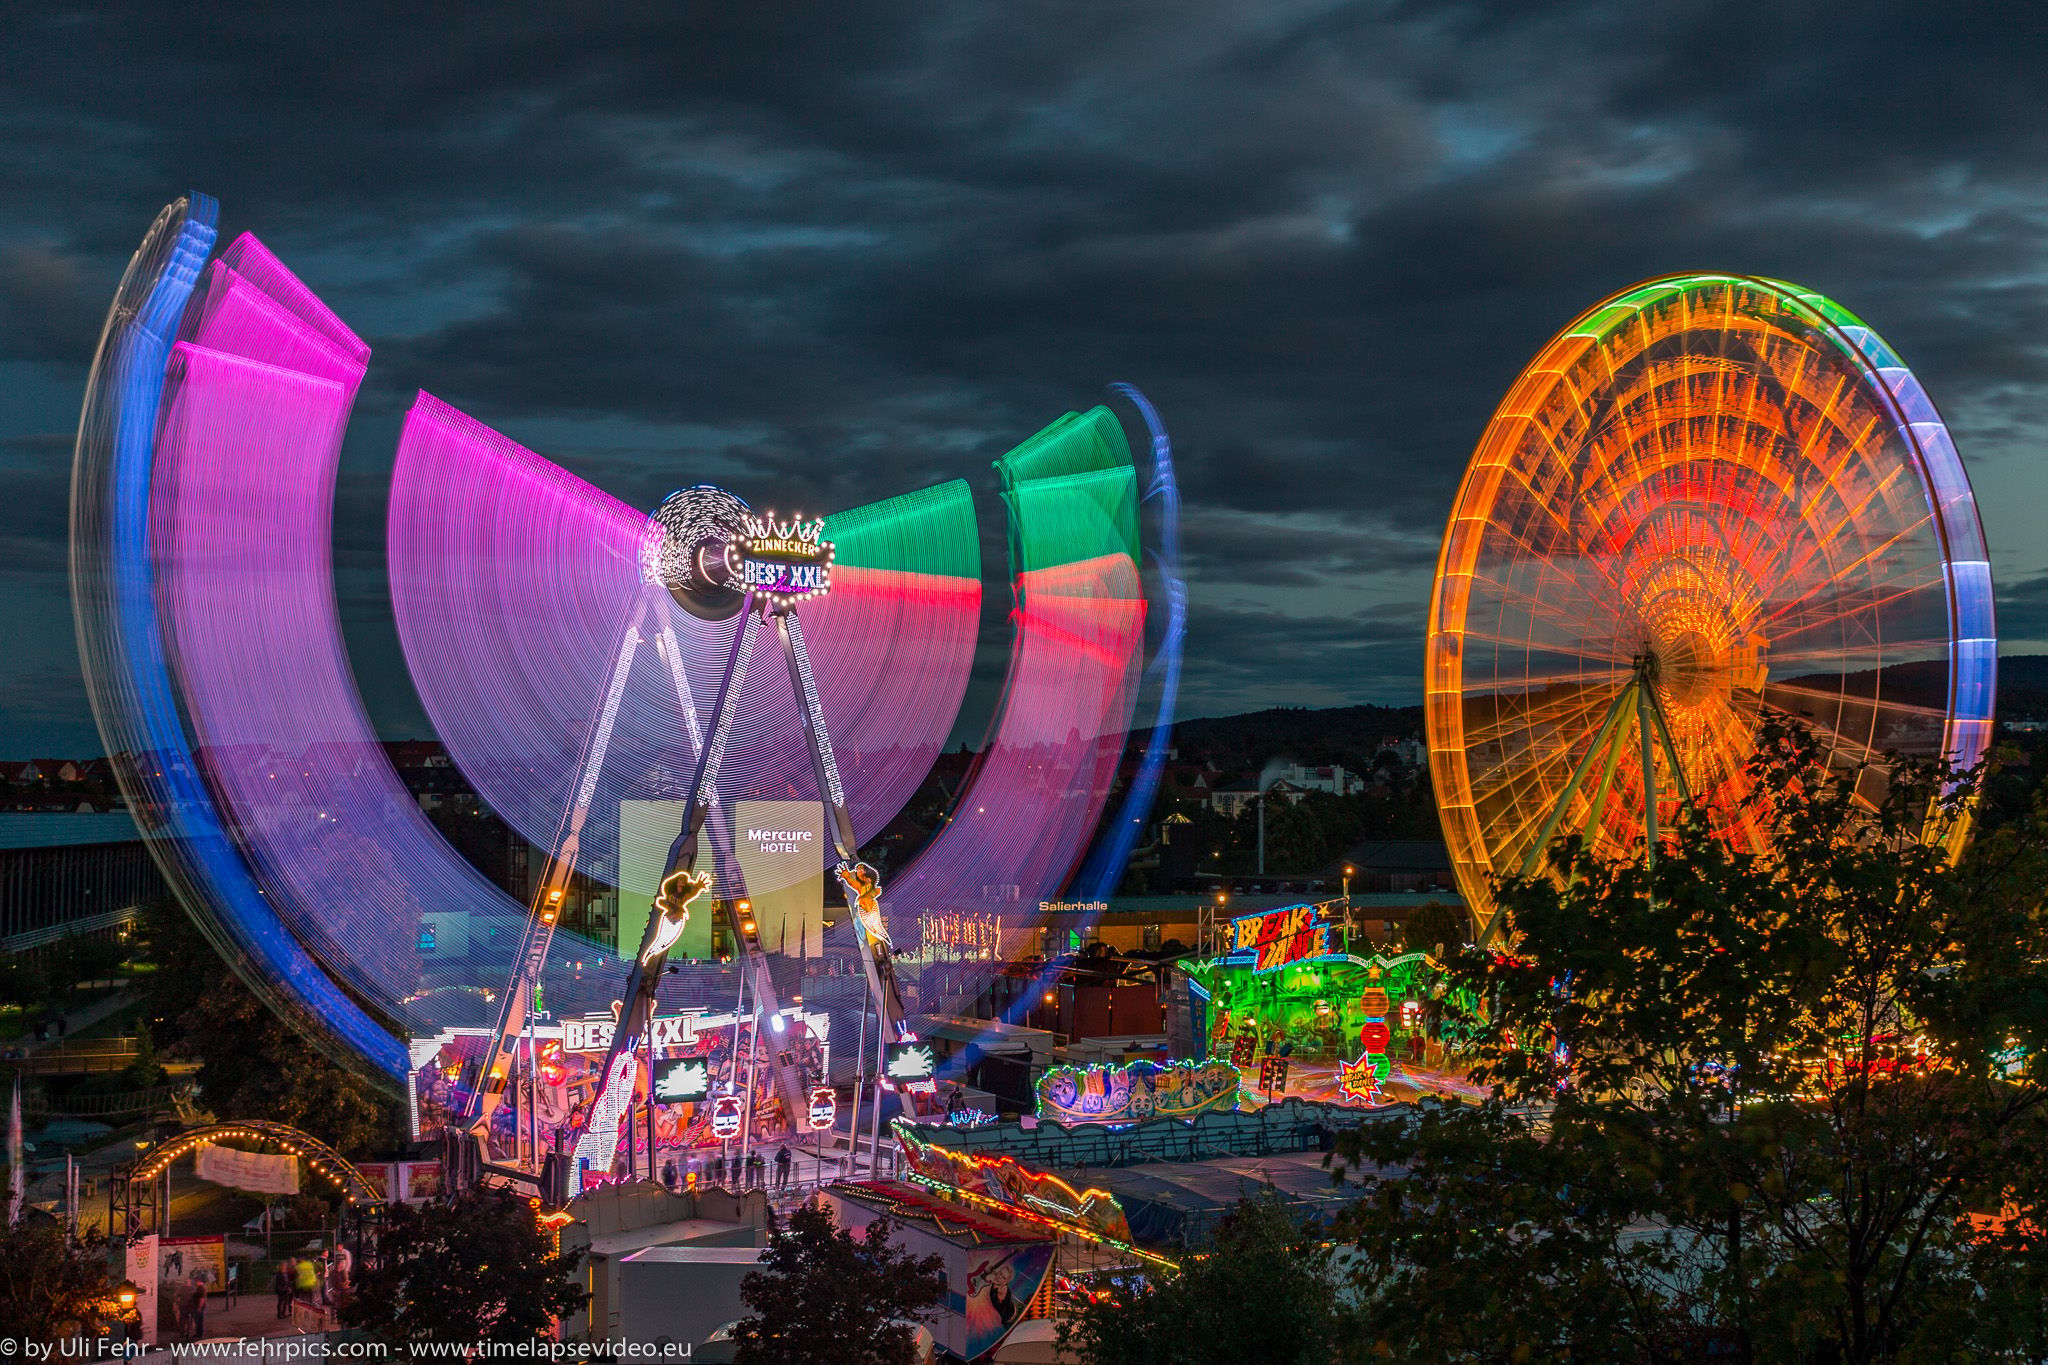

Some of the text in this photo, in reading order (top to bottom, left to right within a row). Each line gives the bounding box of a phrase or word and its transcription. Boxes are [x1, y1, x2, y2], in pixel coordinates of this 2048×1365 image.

[752, 538, 816, 557] ZINNECKER
[744, 559, 825, 589] BEST XXL
[748, 829, 812, 841] Mercure
[760, 843, 800, 853] HOTEL
[1038, 900, 1108, 912] Salierhalle
[1236, 907, 1315, 949] BREAK
[1254, 927, 1327, 972] DANCE
[566, 1022, 617, 1049] BES
